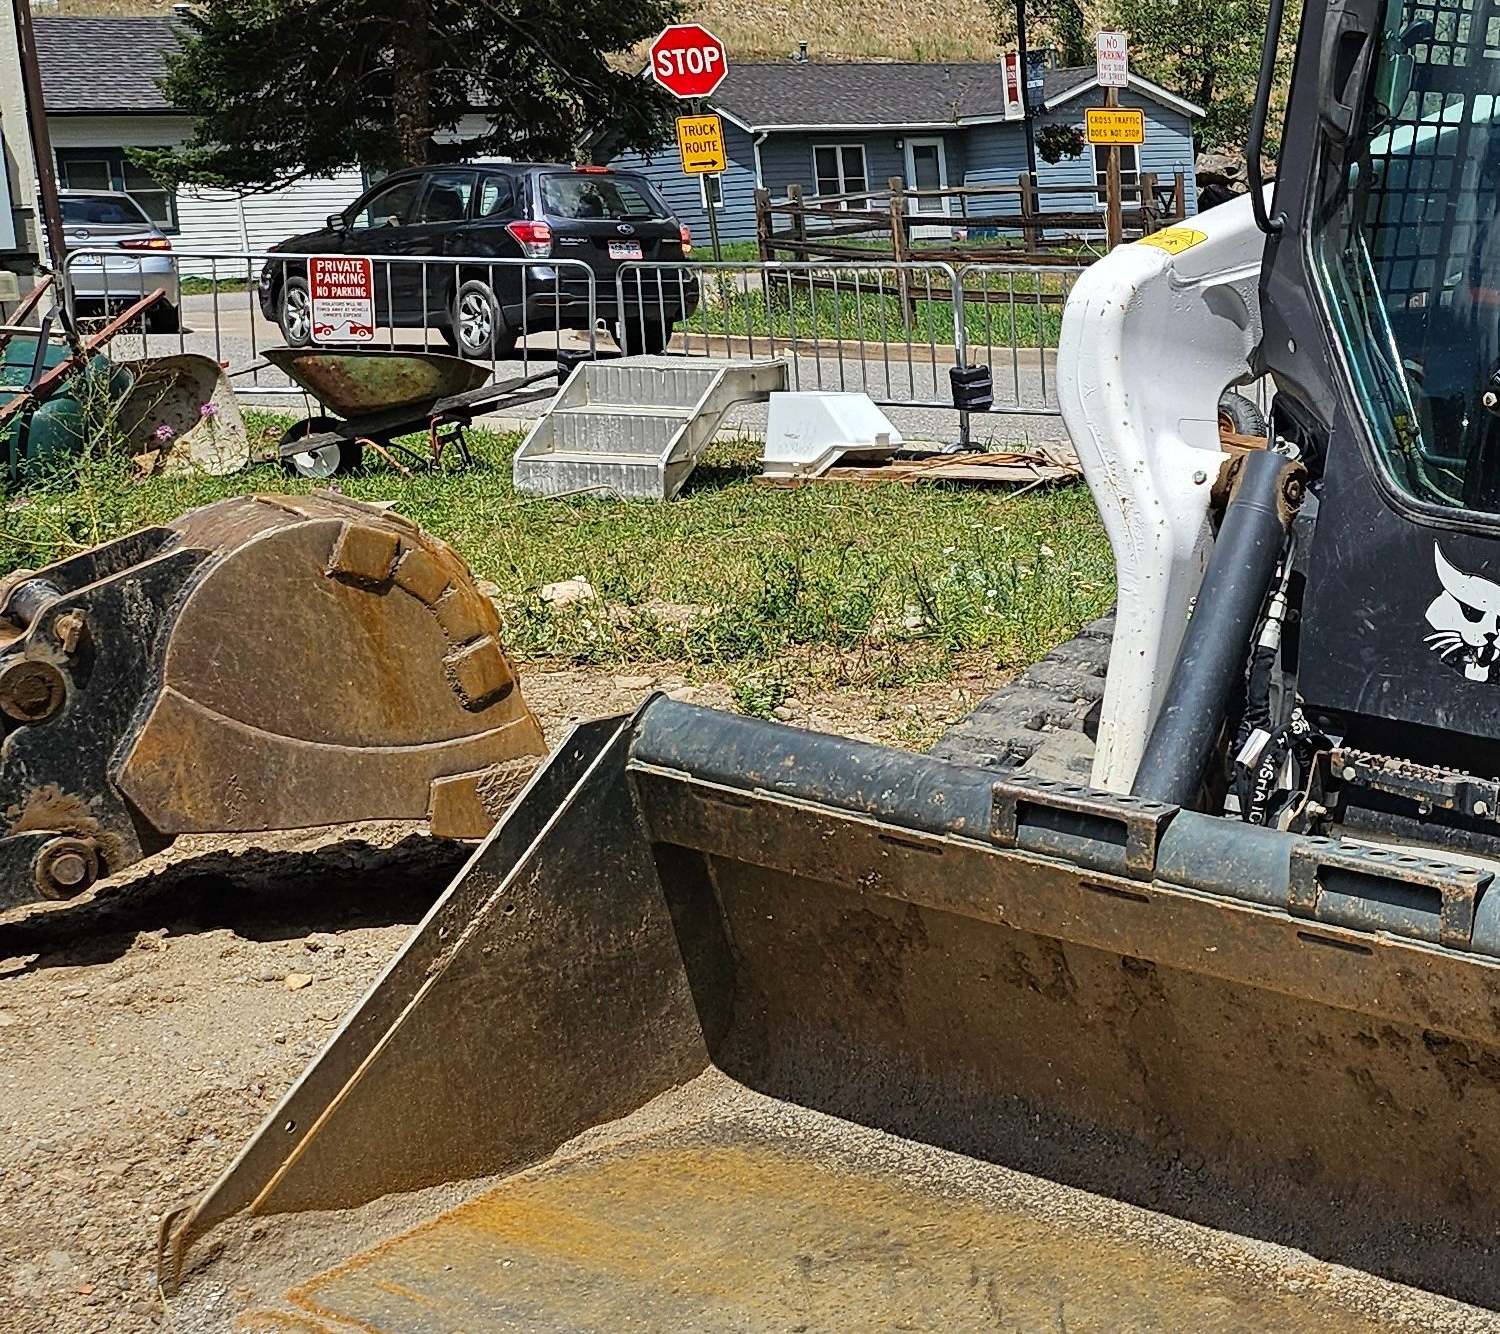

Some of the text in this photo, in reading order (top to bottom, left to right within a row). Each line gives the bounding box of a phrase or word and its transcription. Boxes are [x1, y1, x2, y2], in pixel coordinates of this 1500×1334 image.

[1106, 39, 1118, 48] NO
[1100, 50, 1125, 61] PARKING
[657, 46, 720, 77] STOP
[1090, 116, 1140, 125] CROSS TRAFFIC
[683, 124, 716, 137] TRUCK
[1091, 129, 1140, 138] DOES NOT STOP
[685, 140, 719, 154] ROUTE
[316, 260, 364, 272] PRIVATE
[316, 272, 366, 285] PARKING
[316, 286, 367, 297] NO PARKING
